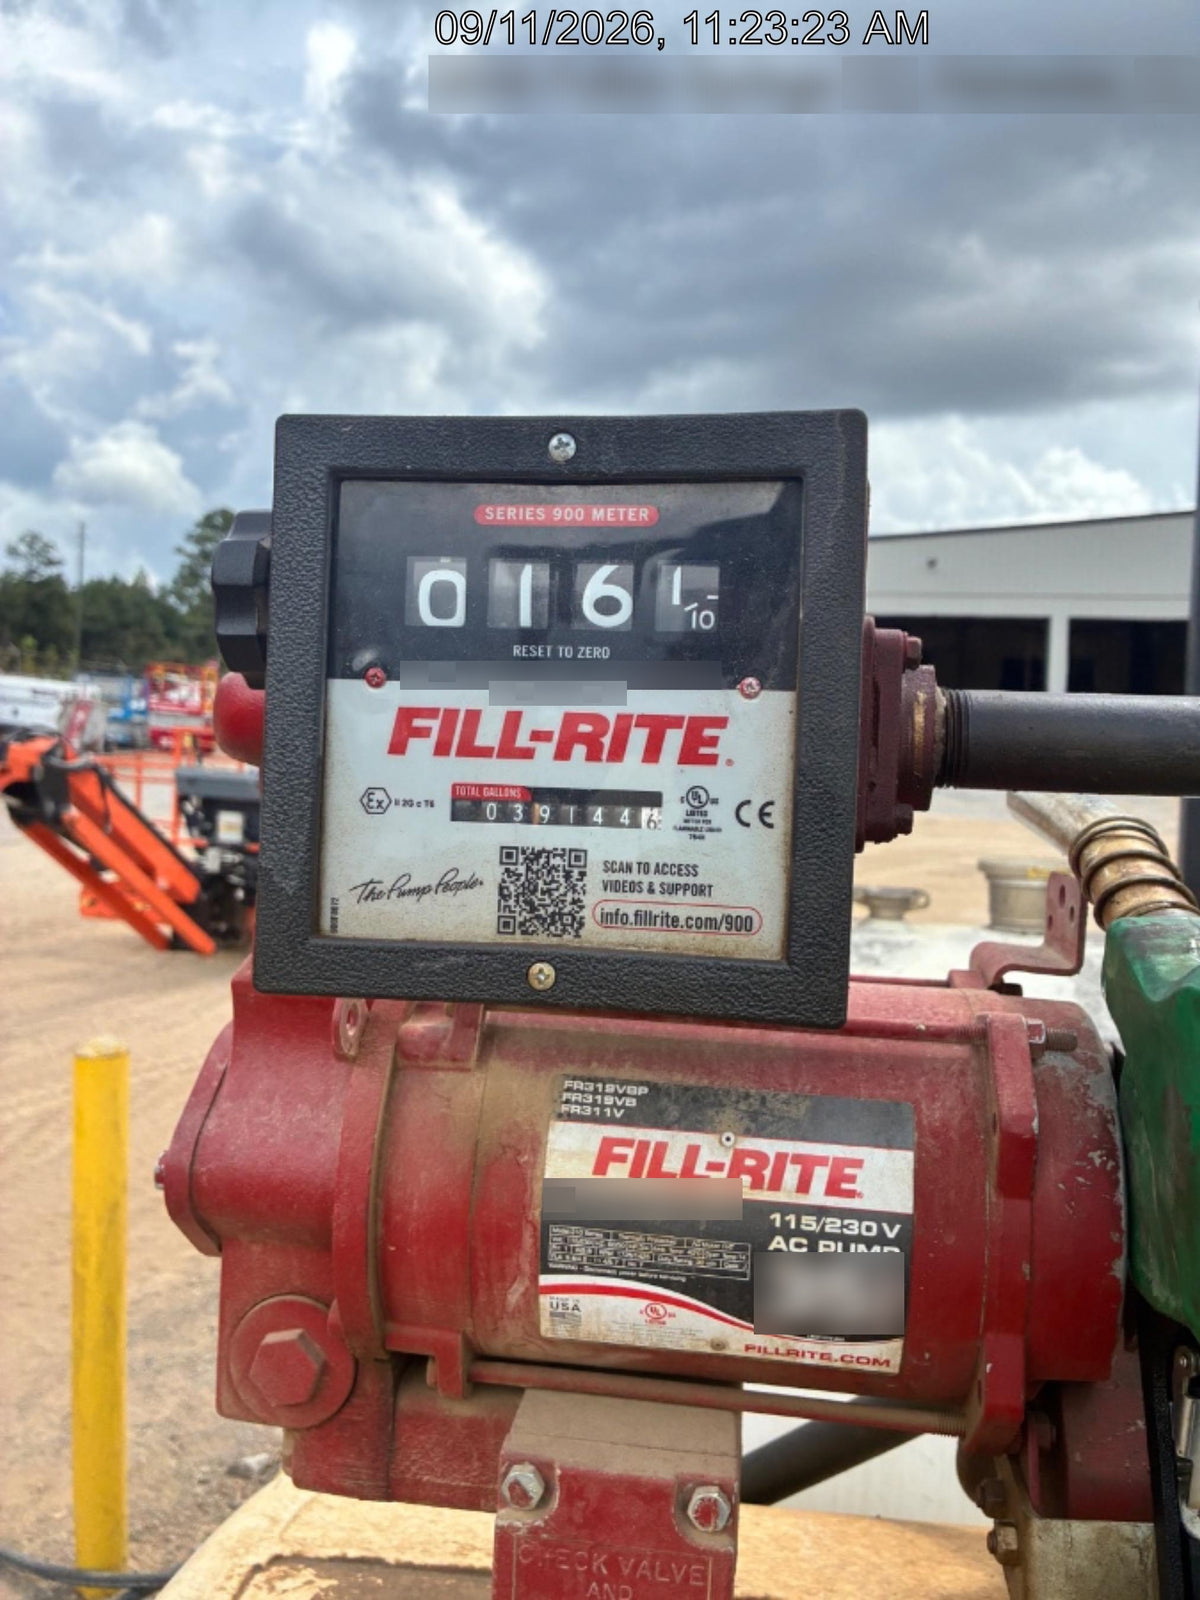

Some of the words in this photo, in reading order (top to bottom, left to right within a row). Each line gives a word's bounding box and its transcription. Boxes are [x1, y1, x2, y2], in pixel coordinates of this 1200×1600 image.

[485, 507, 545, 520] SERIES
[553, 508, 584, 521] 900
[592, 508, 649, 521] METER
[513, 645, 551, 657] RESET
[558, 646, 573, 658] TO
[577, 646, 610, 659] ZERO
[387, 706, 730, 766] FILL-RITE
[455, 786, 481, 797] TOTAL
[483, 788, 522, 799] GALLONS
[602, 860, 632, 874] SCAN
[636, 862, 650, 875] TO
[653, 862, 699, 877] ACCESS
[349, 878, 387, 904] The
[386, 872, 433, 903] Pump
[602, 879, 643, 893] VIDEOS
[647, 881, 656, 895] &
[659, 883, 714, 898] SUPPORT
[600, 907, 753, 932] info.fillrite.com/900
[561, 1104, 625, 1119] FR311V
[592, 1136, 864, 1199] FILL-RITE
[769, 1212, 878, 1237] 115/230
[881, 1222, 902, 1239] V
[768, 1235, 809, 1253] AC
[619, 1556, 706, 1586] VALVE
[586, 1581, 633, 1600] AND
